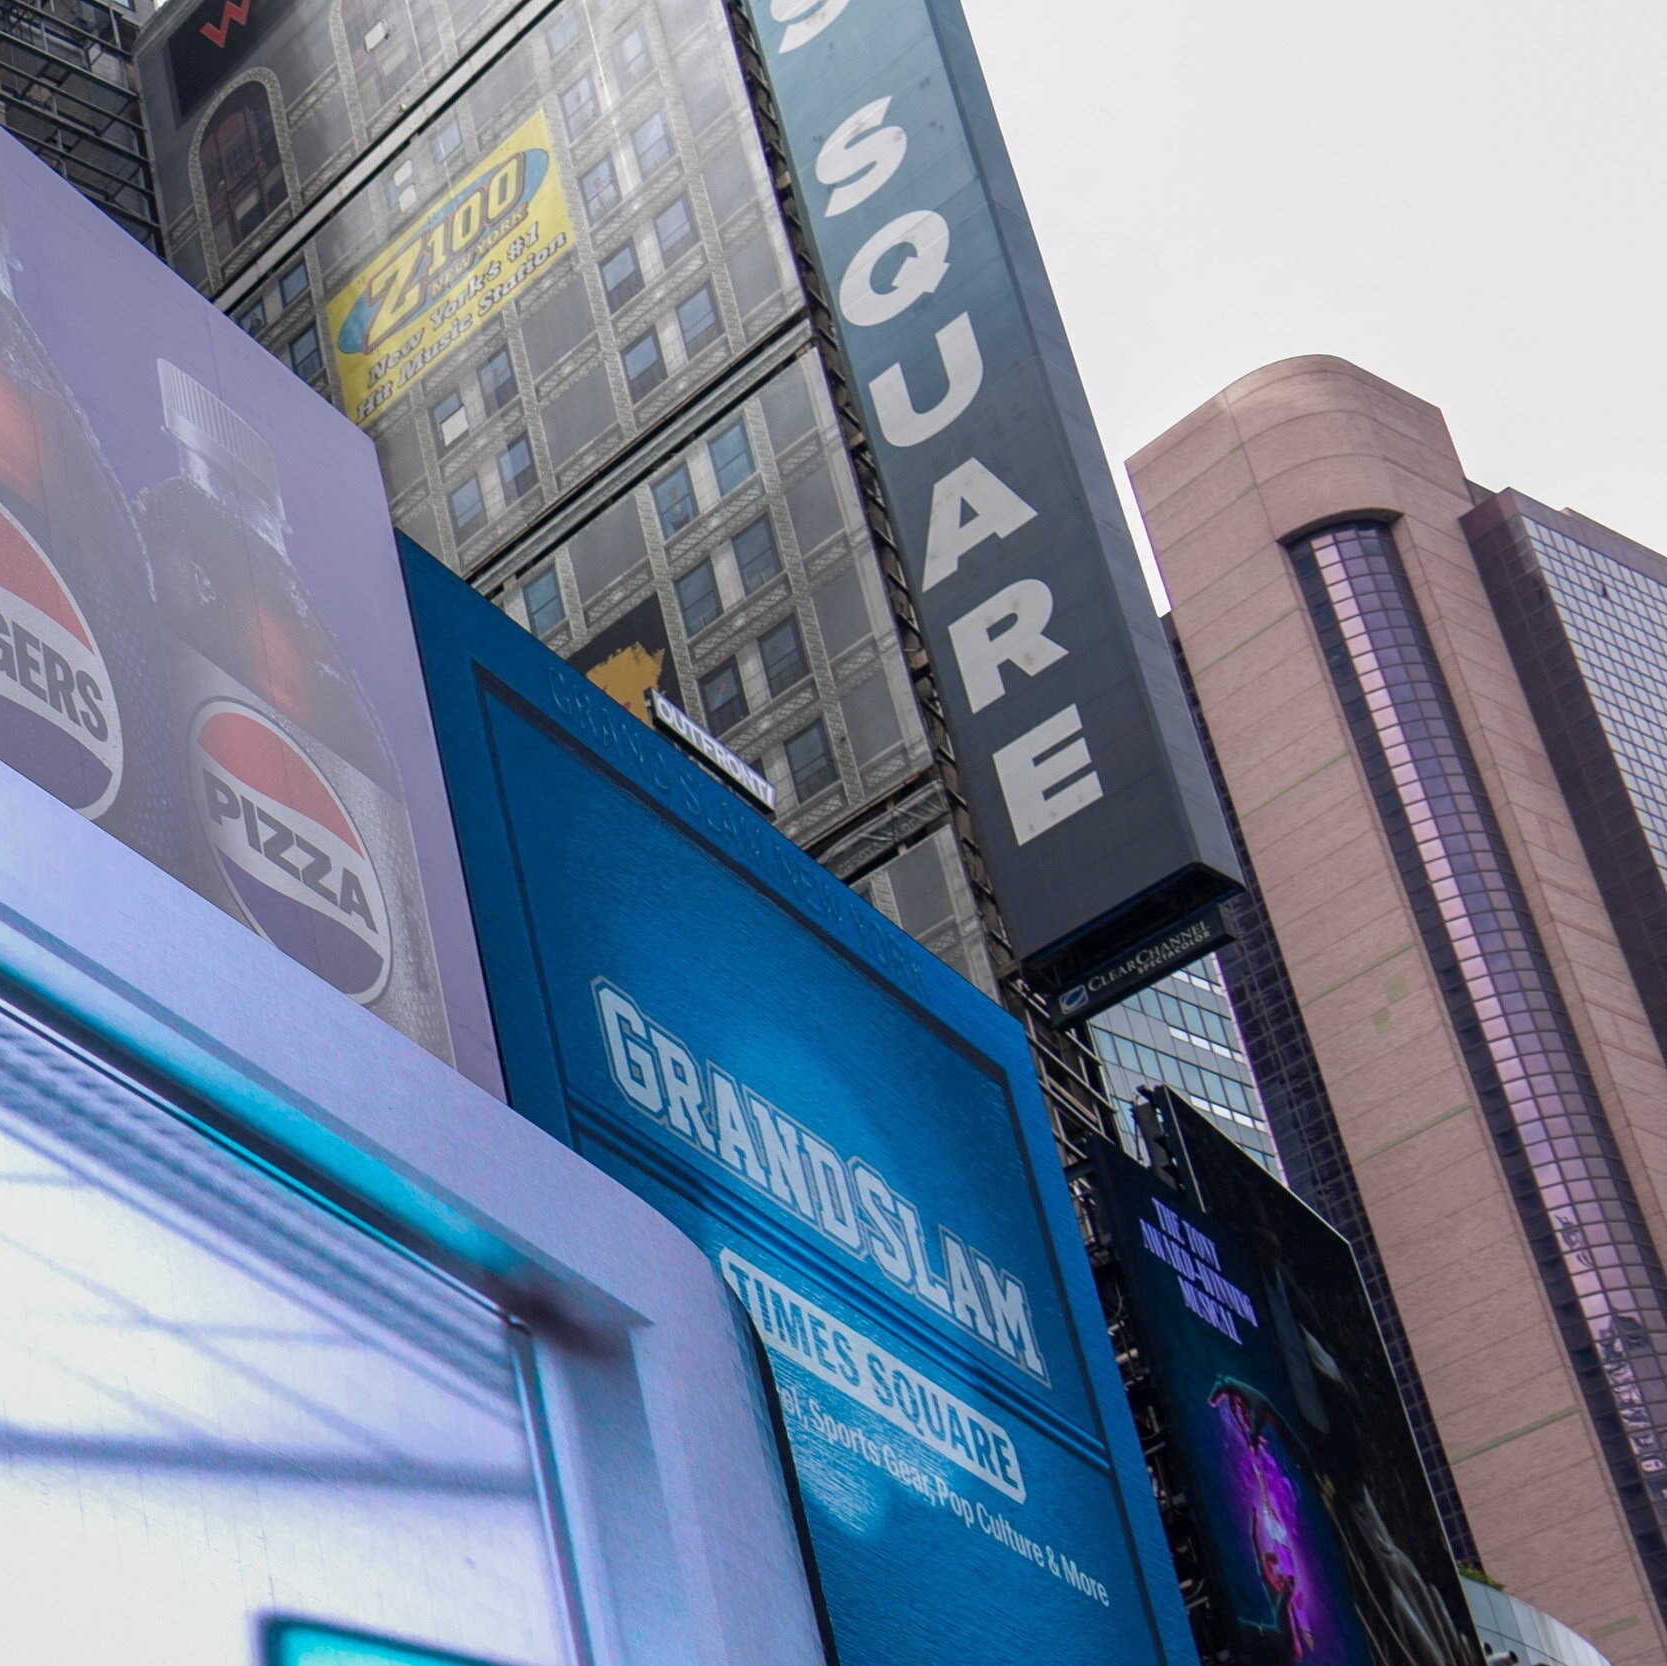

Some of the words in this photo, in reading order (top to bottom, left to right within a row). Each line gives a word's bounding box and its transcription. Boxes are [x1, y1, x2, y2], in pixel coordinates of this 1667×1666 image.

[356, 381, 394, 422] Hit
[398, 315, 473, 389] Music
[478, 232, 567, 318] Station
[364, 151, 527, 356] Z100
[368, 328, 425, 389] New
[430, 260, 501, 331] York's
[506, 222, 540, 264] #1
[816, 96, 1104, 847] SQUARE
[201, 767, 379, 935] PIZZA
[1137, 931, 1211, 975] SPECTACOLOR
[730, 1259, 861, 1388] TIMES
[871, 1364, 1021, 1490] SQUARE
[808, 1399, 880, 1467] Sports
[883, 1446, 936, 1507] Gear,
[936, 1480, 975, 1528] Pop
[976, 1503, 1045, 1569] Culture
[1044, 1543, 1062, 1579] &
[1060, 1554, 1110, 1607] More
